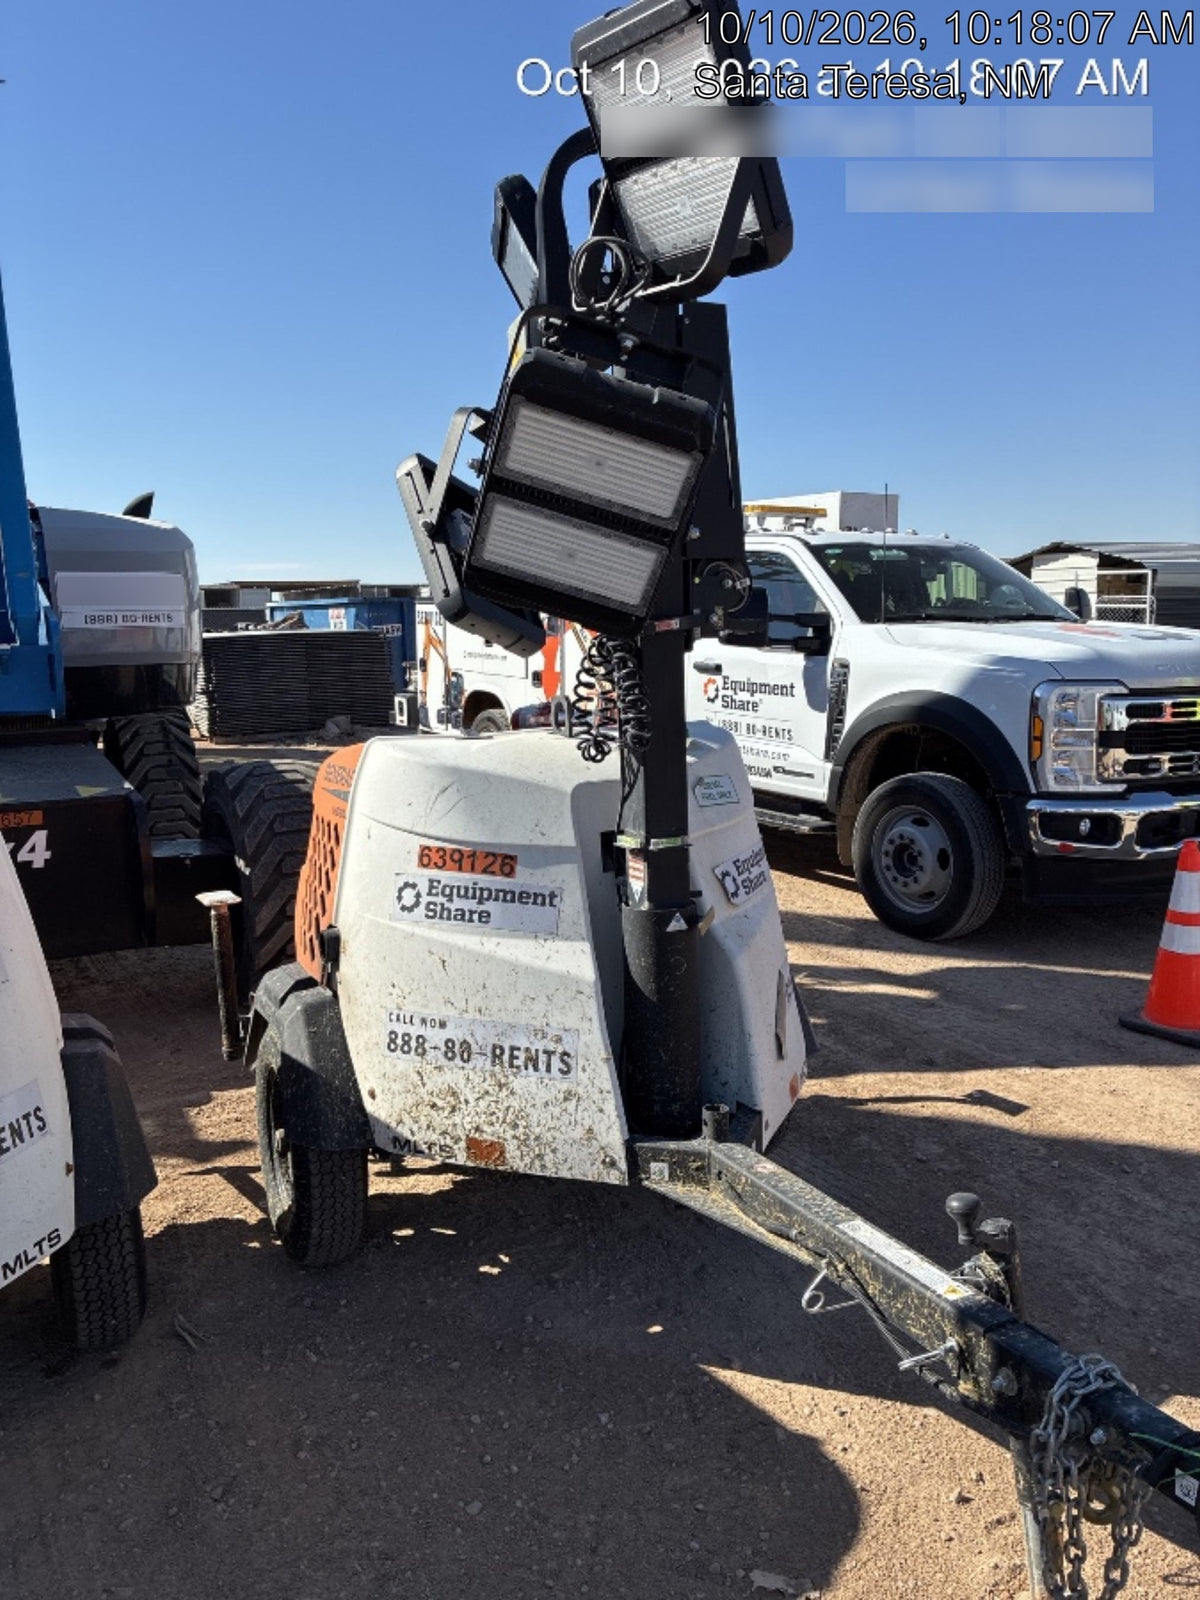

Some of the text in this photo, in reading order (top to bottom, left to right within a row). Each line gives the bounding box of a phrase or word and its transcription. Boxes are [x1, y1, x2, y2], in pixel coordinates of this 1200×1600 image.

[721, 675, 796, 698] Equipment
[418, 845, 517, 879] 639126
[426, 878, 558, 908] Equipment
[424, 901, 492, 925] Share
[388, 1012, 448, 1030] CALL NOW
[386, 1029, 573, 1077] 888-80-RENTS
[1, 1227, 62, 1281] MLTS
